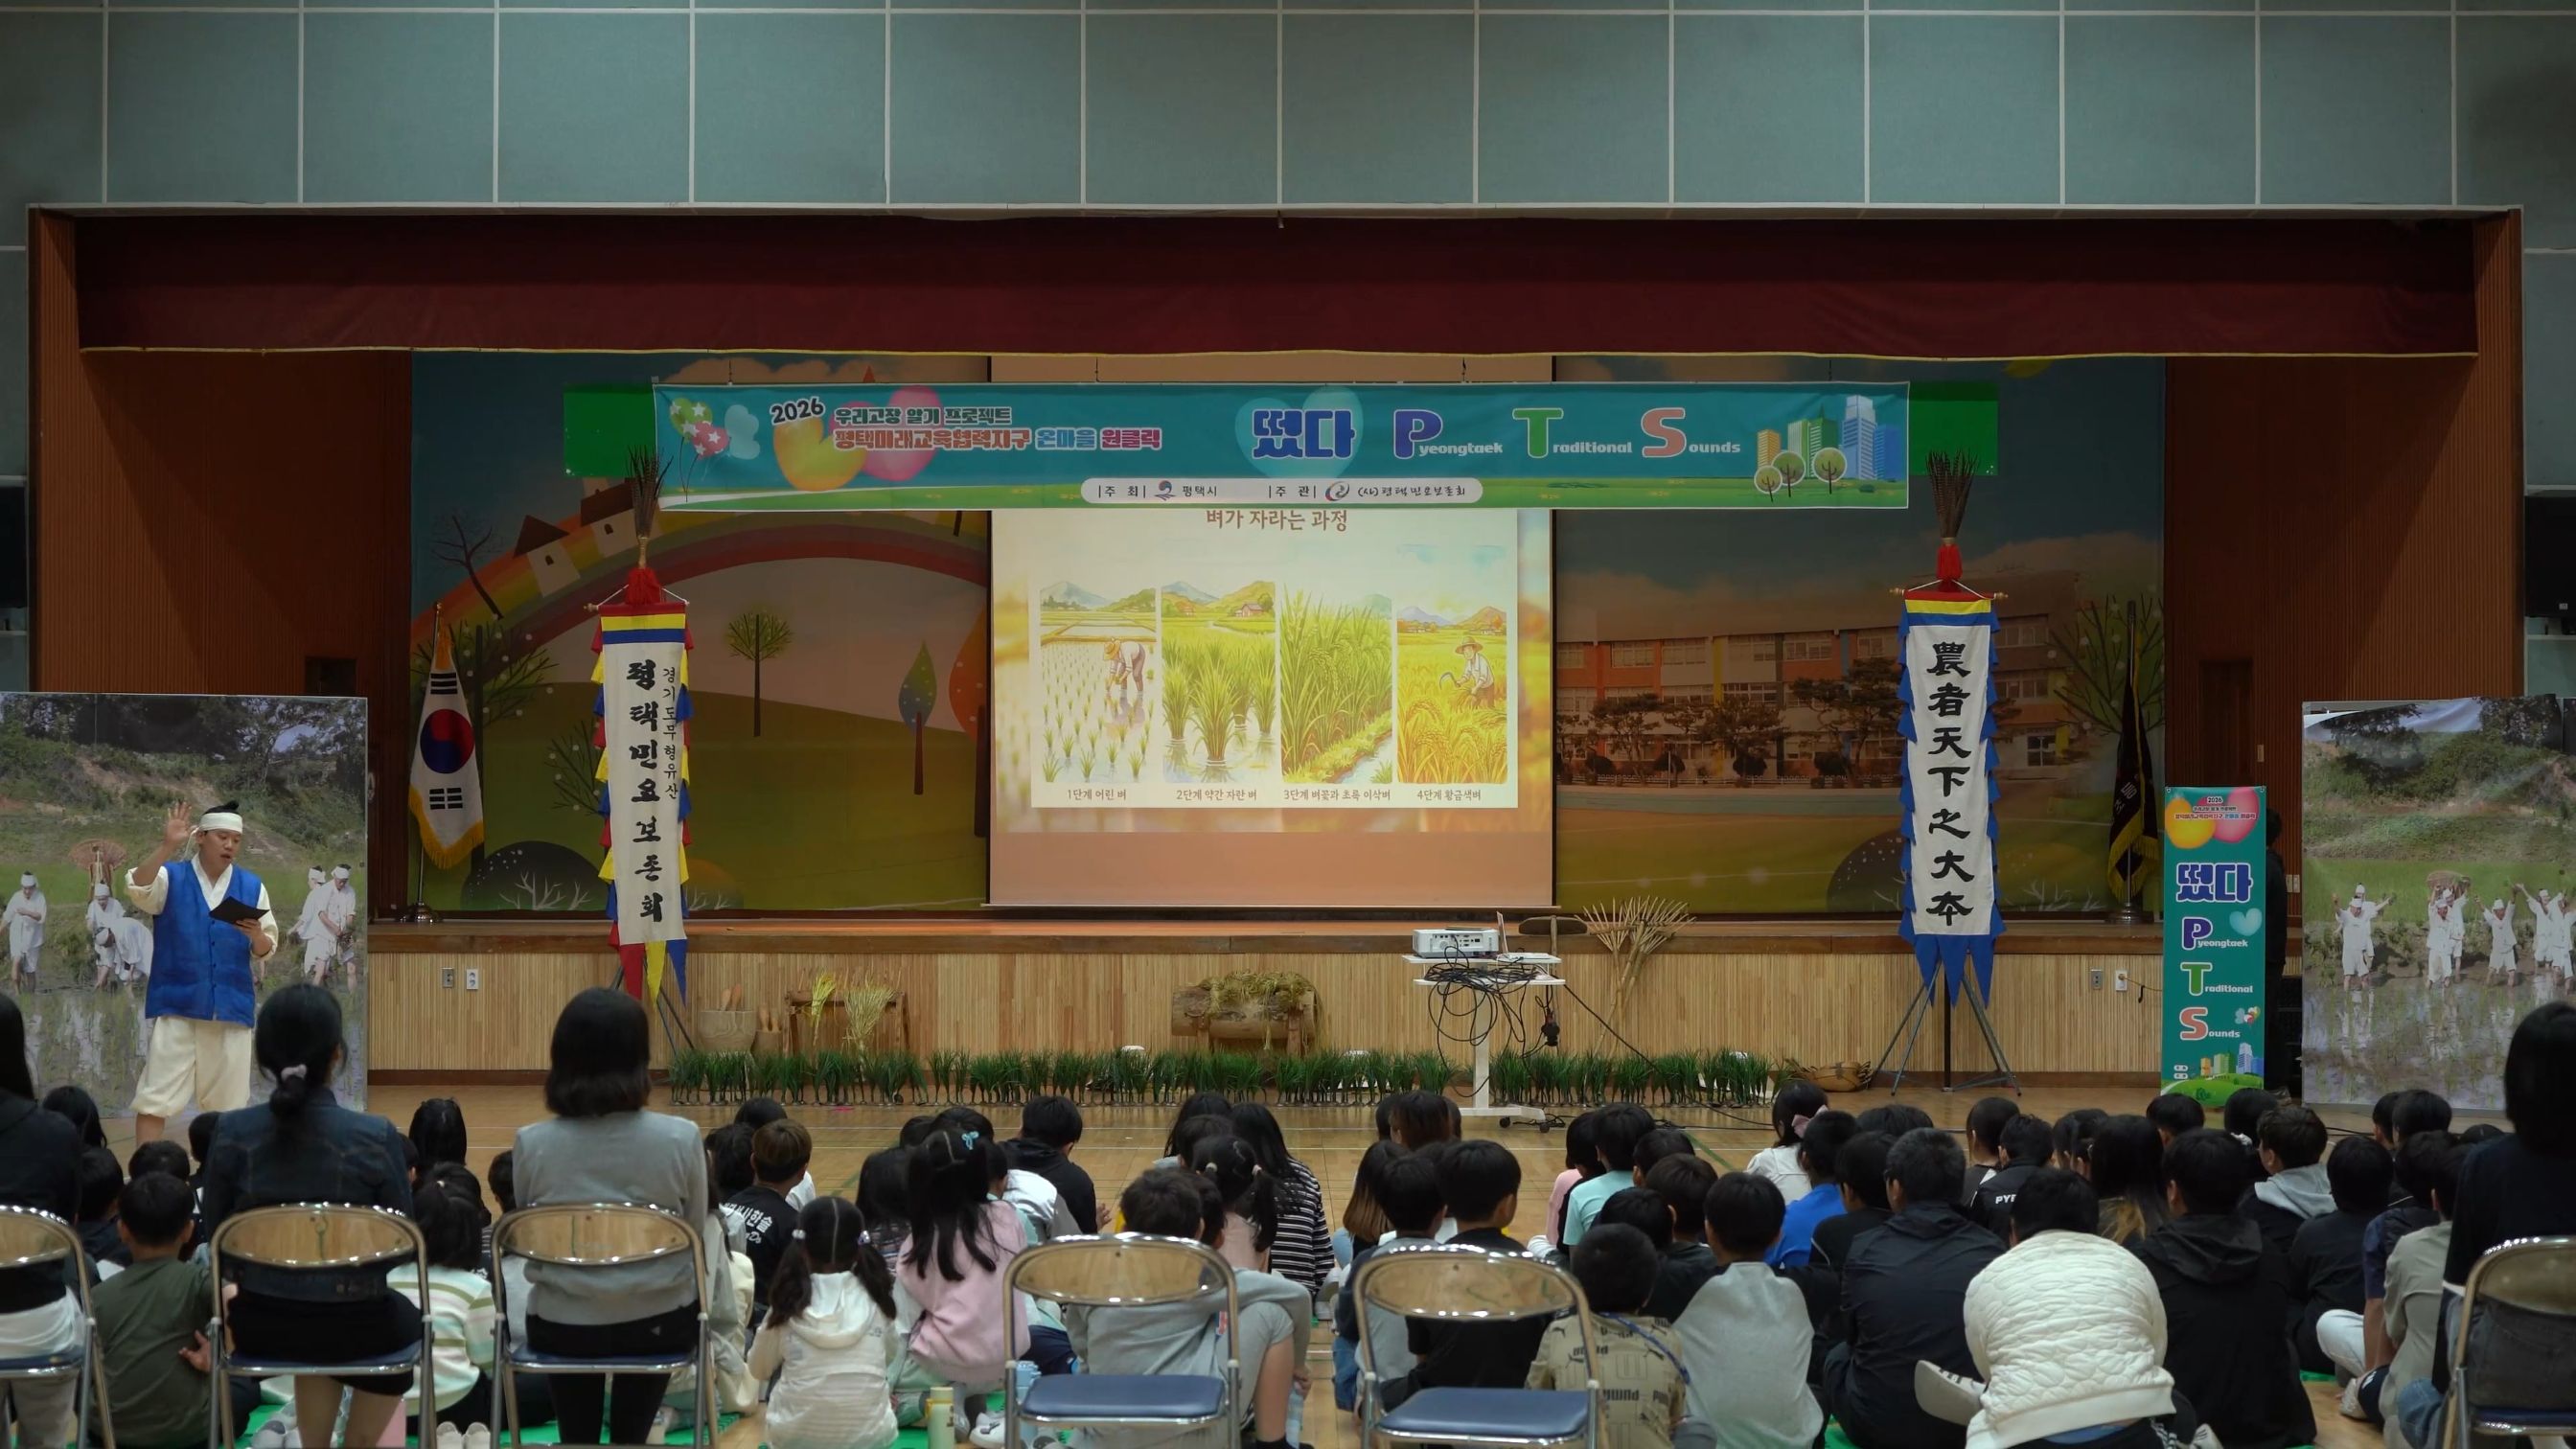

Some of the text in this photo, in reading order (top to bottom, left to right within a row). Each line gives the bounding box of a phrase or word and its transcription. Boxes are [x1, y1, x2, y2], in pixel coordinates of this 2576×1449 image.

[770, 396, 825, 425] 2026
[835, 407, 1011, 426] 우리고장 알기 프로젝트
[835, 428, 1162, 449] 평택미래교육협력지구 온마을 원클릭
[1253, 409, 1356, 459] 떴다
[1641, 407, 1741, 458] Sounds
[1183, 486, 1217, 497] 평택시
[1207, 510, 1347, 532] 벼가 자라는 과정
[627, 658, 663, 923] 평택민요보존회
[1067, 790, 1127, 801] 1단계 어린 벼
[1176, 790, 1202, 801] 2단계
[1205, 790, 1224, 800] 약간
[1227, 790, 1245, 800] 자란
[1283, 790, 1309, 801] 3단계
[1416, 790, 1442, 801] 4단계
[2176, 862, 2253, 903] 떴다
[2179, 1006, 2241, 1041] Sounds
